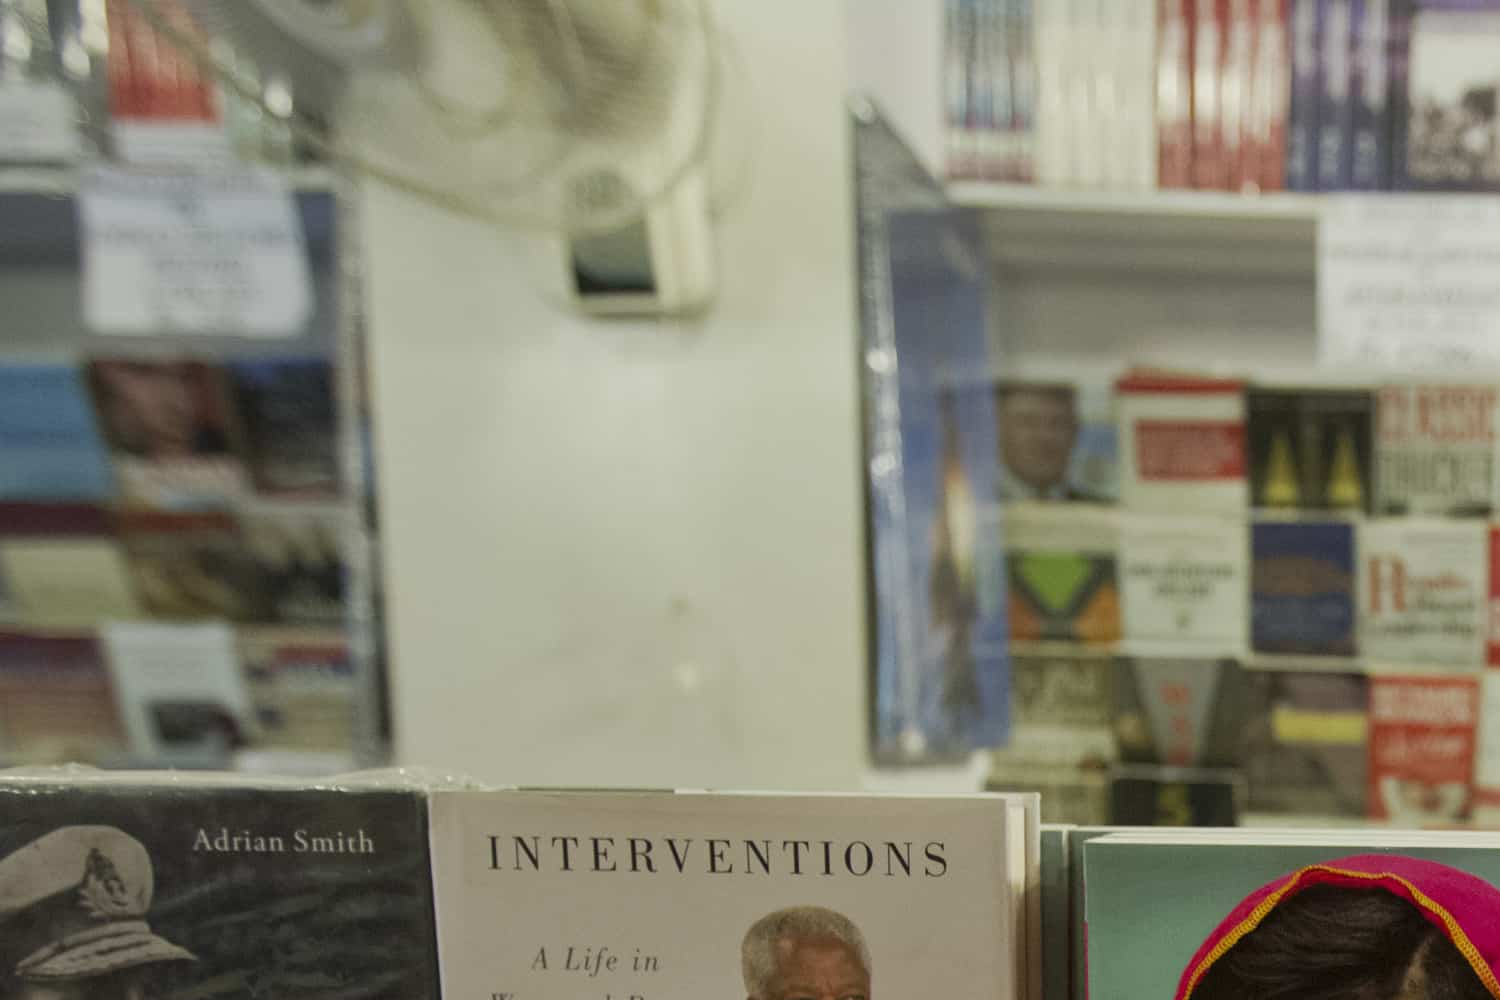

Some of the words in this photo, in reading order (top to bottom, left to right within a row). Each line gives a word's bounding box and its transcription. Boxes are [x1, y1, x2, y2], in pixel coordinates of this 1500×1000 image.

[193, 828, 284, 853] Adrian
[293, 828, 375, 854] Smith
[488, 835, 949, 877] INTERVENTIONS
[531, 948, 548, 970] A
[565, 946, 617, 976] Life
[632, 948, 661, 971] in
